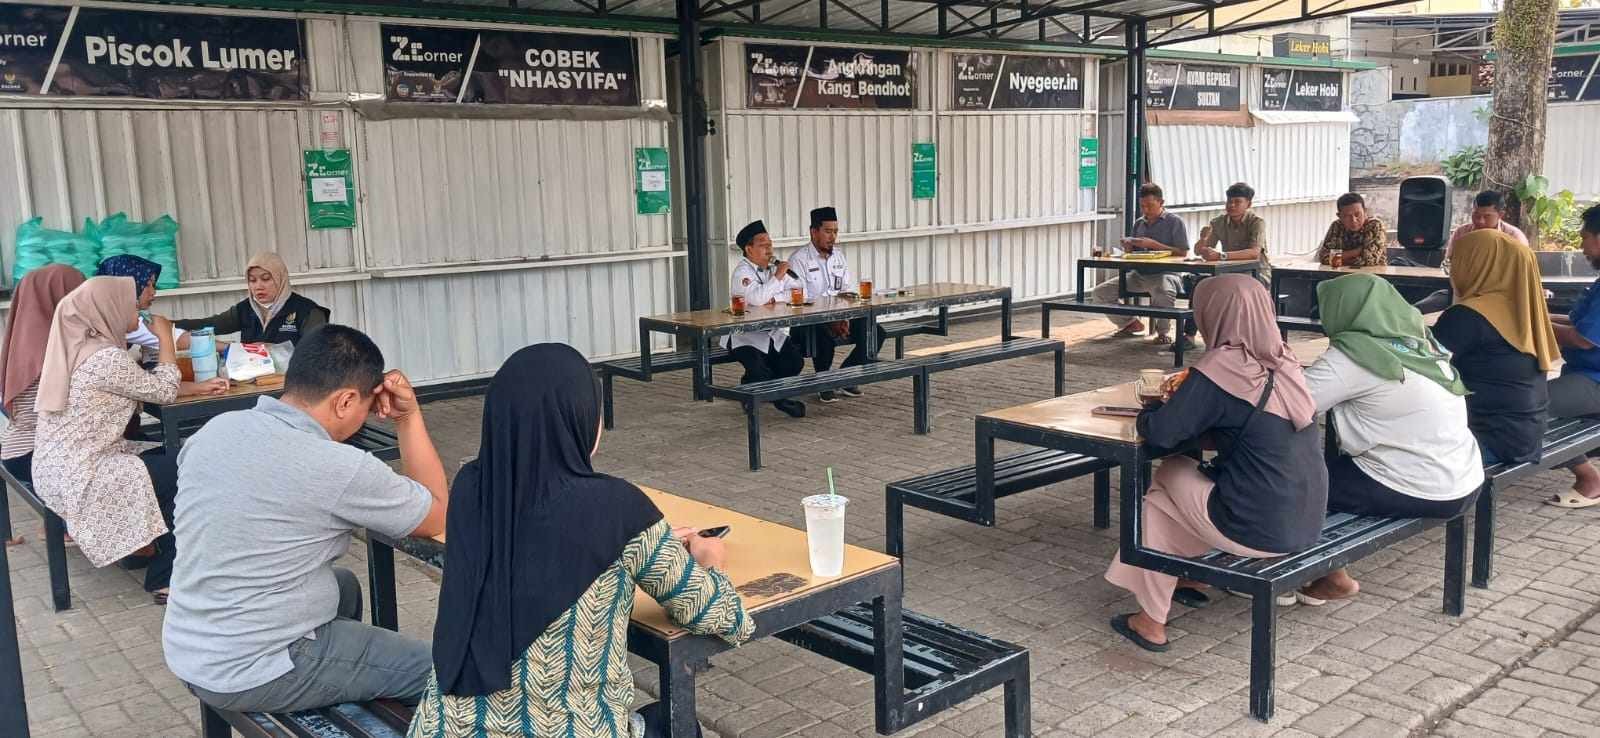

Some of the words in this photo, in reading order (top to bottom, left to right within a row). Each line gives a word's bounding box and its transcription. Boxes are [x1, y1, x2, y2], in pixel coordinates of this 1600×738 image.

[85, 36, 194, 68] Piscok
[200, 41, 295, 71] Lumer
[525, 49, 601, 69] COBEK
[498, 69, 627, 90] "NHASYIFA"
[1009, 72, 1078, 93] Nyegeer.in
[1187, 71, 1206, 86] AYAM
[1197, 92, 1221, 106] SULTAN
[1295, 82, 1319, 96] Leker
[1320, 83, 1339, 96] Hobi
